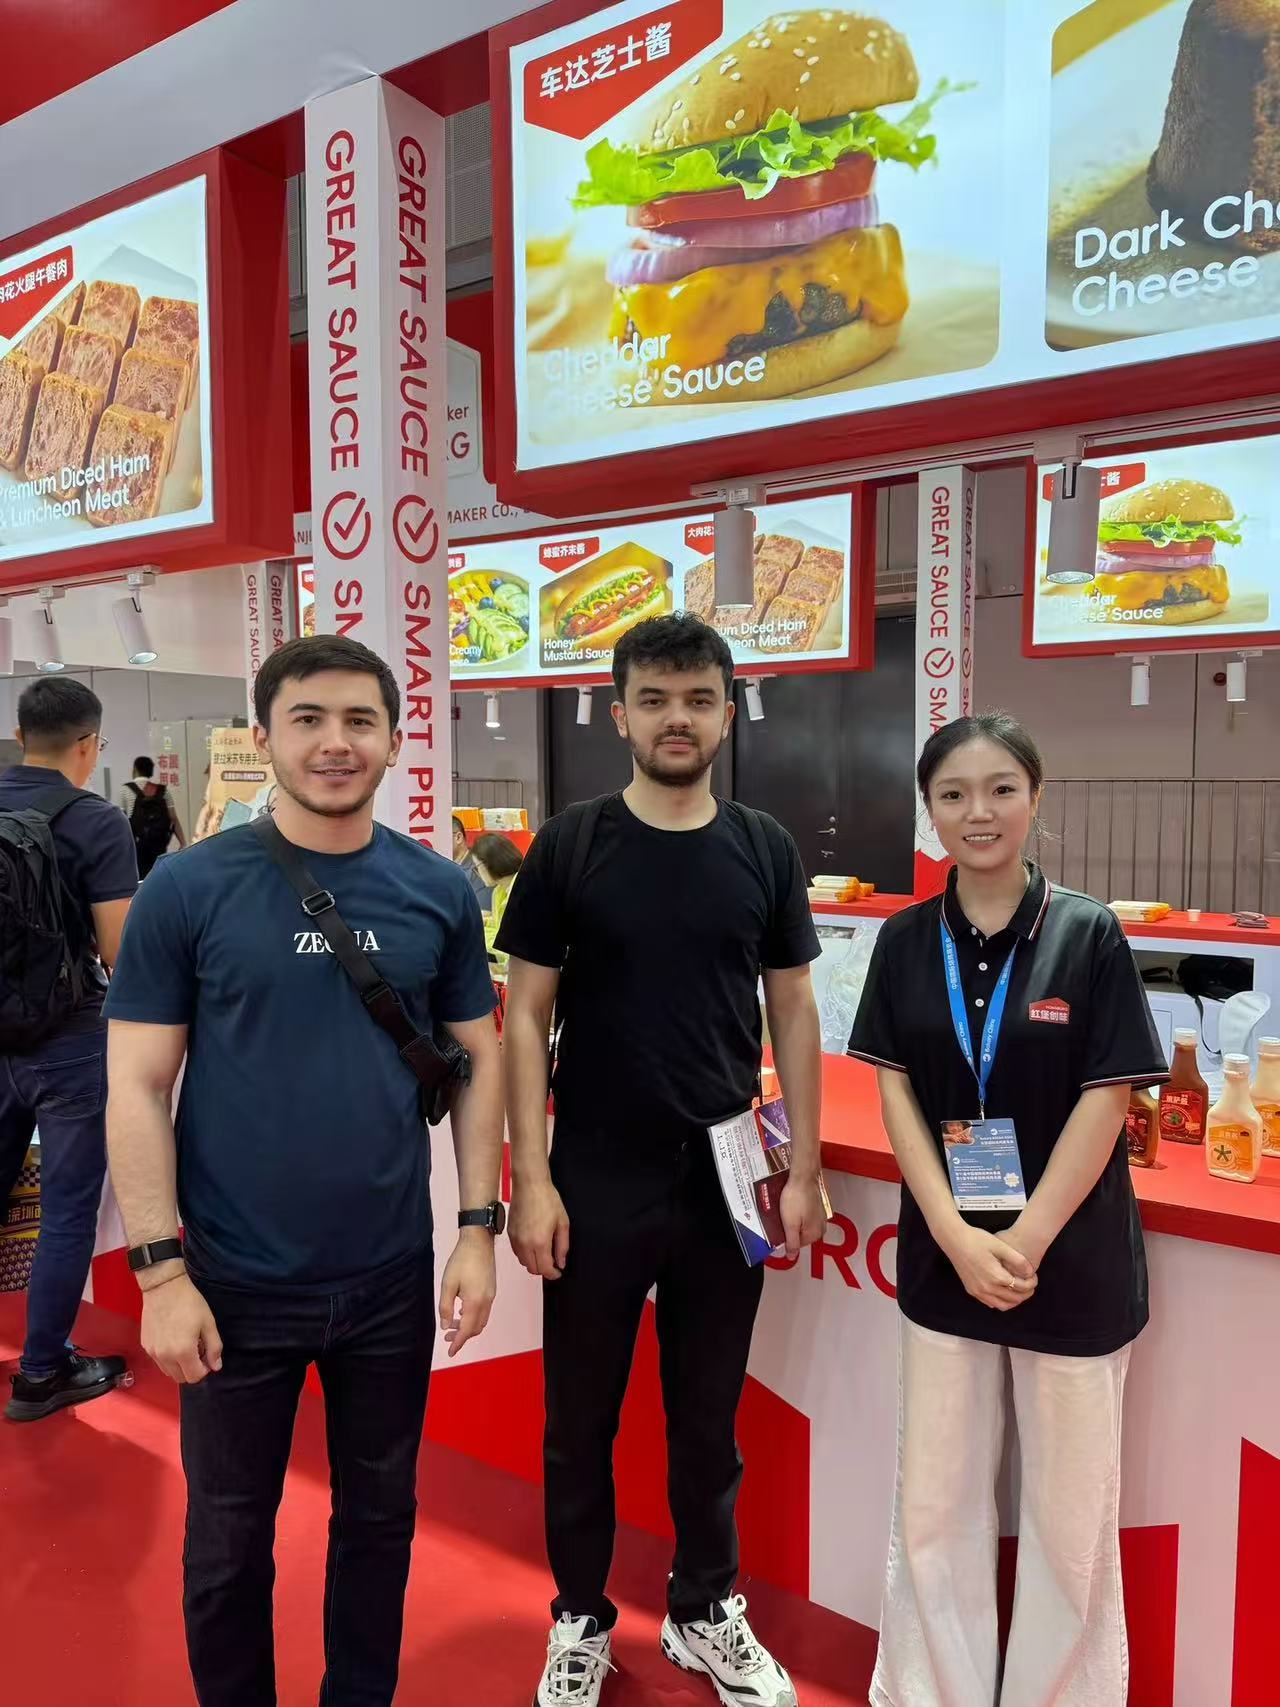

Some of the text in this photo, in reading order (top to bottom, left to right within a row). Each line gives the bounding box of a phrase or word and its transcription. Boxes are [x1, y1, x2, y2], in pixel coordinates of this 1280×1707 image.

[539, 21, 672, 99] 车达芝士酱
[325, 130, 357, 290] GREAT
[1074, 190, 1280, 269] Dark Ch
[1072, 255, 1260, 317] Cheese
[328, 306, 360, 472] SAUCE
[662, 354, 766, 399] Sauce
[446, 431, 471, 461] G
[61, 458, 105, 490] Diced
[111, 454, 150, 480] Ham
[398, 135, 435, 850] GREAT SAUCE SMART PRI
[86, 484, 130, 513] Meat
[931, 486, 950, 559] GREAT
[247, 574, 258, 625] GREAT
[270, 574, 284, 654] GREAT SA
[930, 565, 950, 638] SAUCE
[1111, 606, 1164, 622] Sauce
[543, 638, 576, 651] Honey
[741, 619, 774, 635] Diced
[777, 618, 807, 632] Ham
[758, 633, 792, 647] Meat
[543, 647, 584, 662] Mustard
